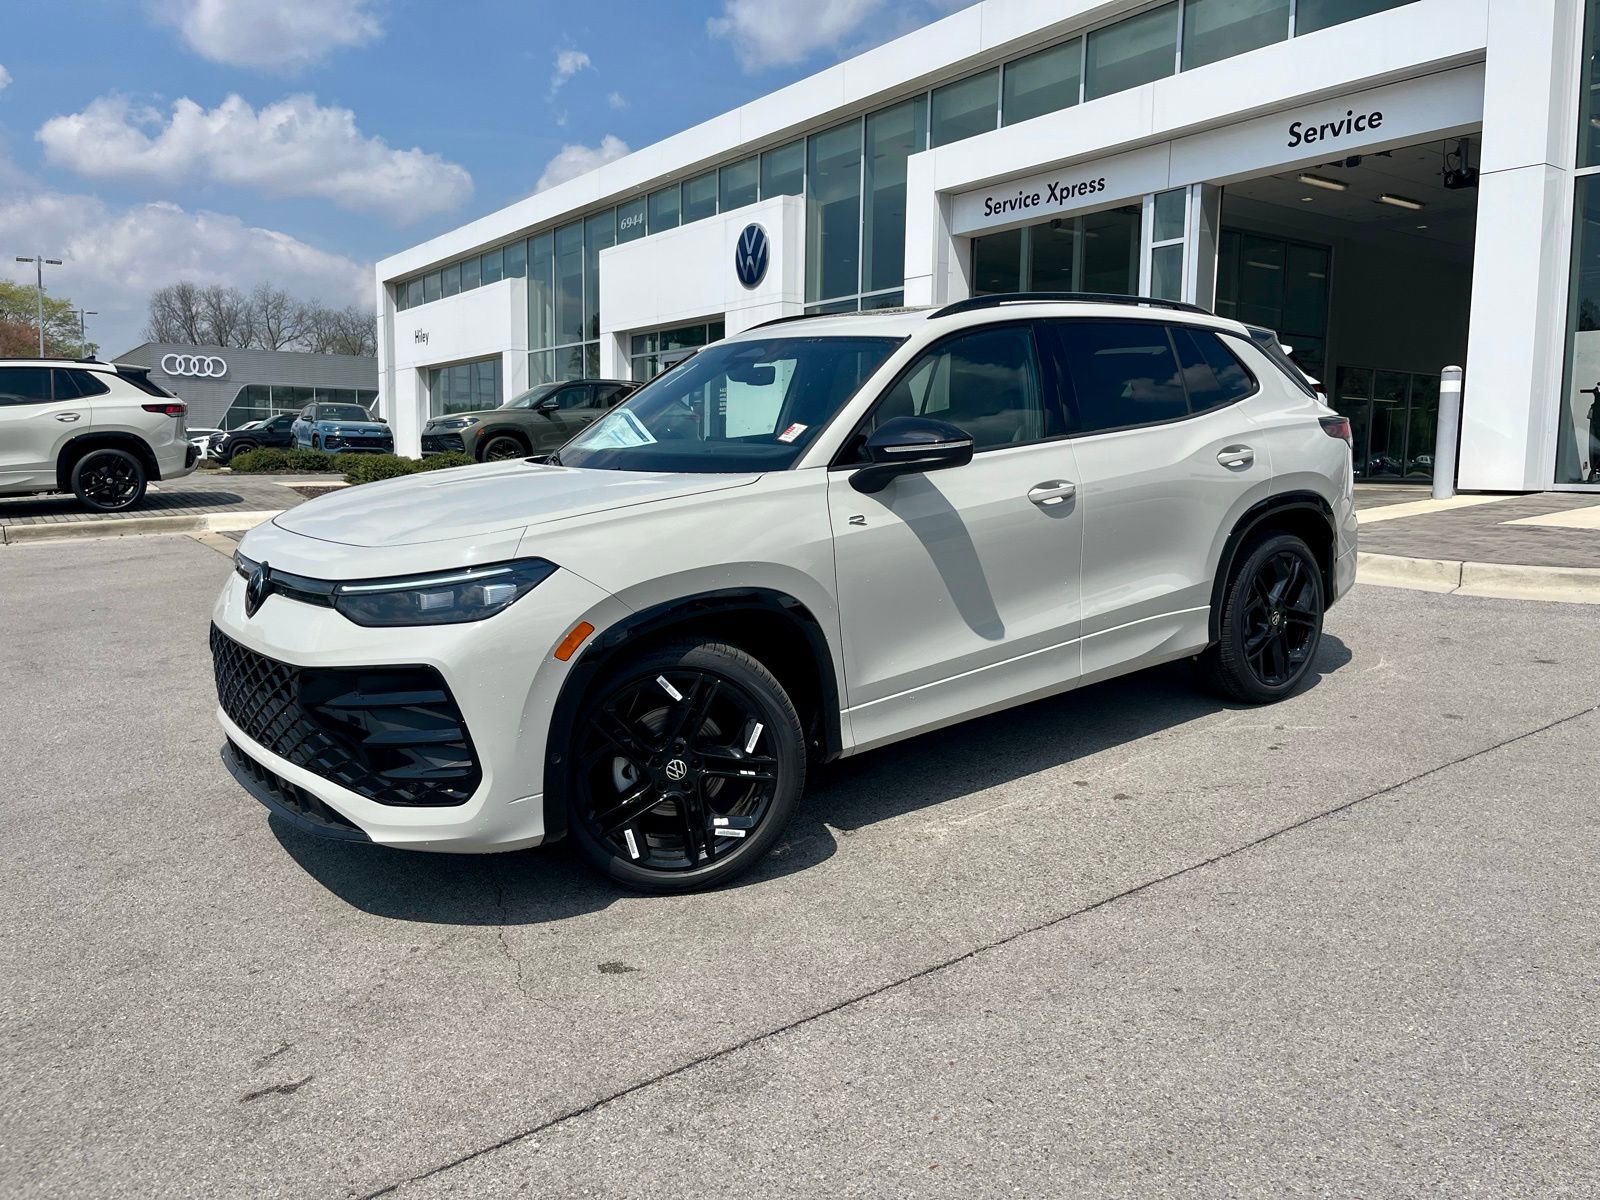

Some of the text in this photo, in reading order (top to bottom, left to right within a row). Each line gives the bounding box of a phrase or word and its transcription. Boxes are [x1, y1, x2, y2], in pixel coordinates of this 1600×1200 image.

[1287, 109, 1383, 147] Service
[984, 177, 1106, 217] Service Xpress
[620, 213, 643, 230] 6944
[736, 223, 769, 287] VW
[414, 327, 430, 346] Hiley
[665, 759, 687, 780] VW
